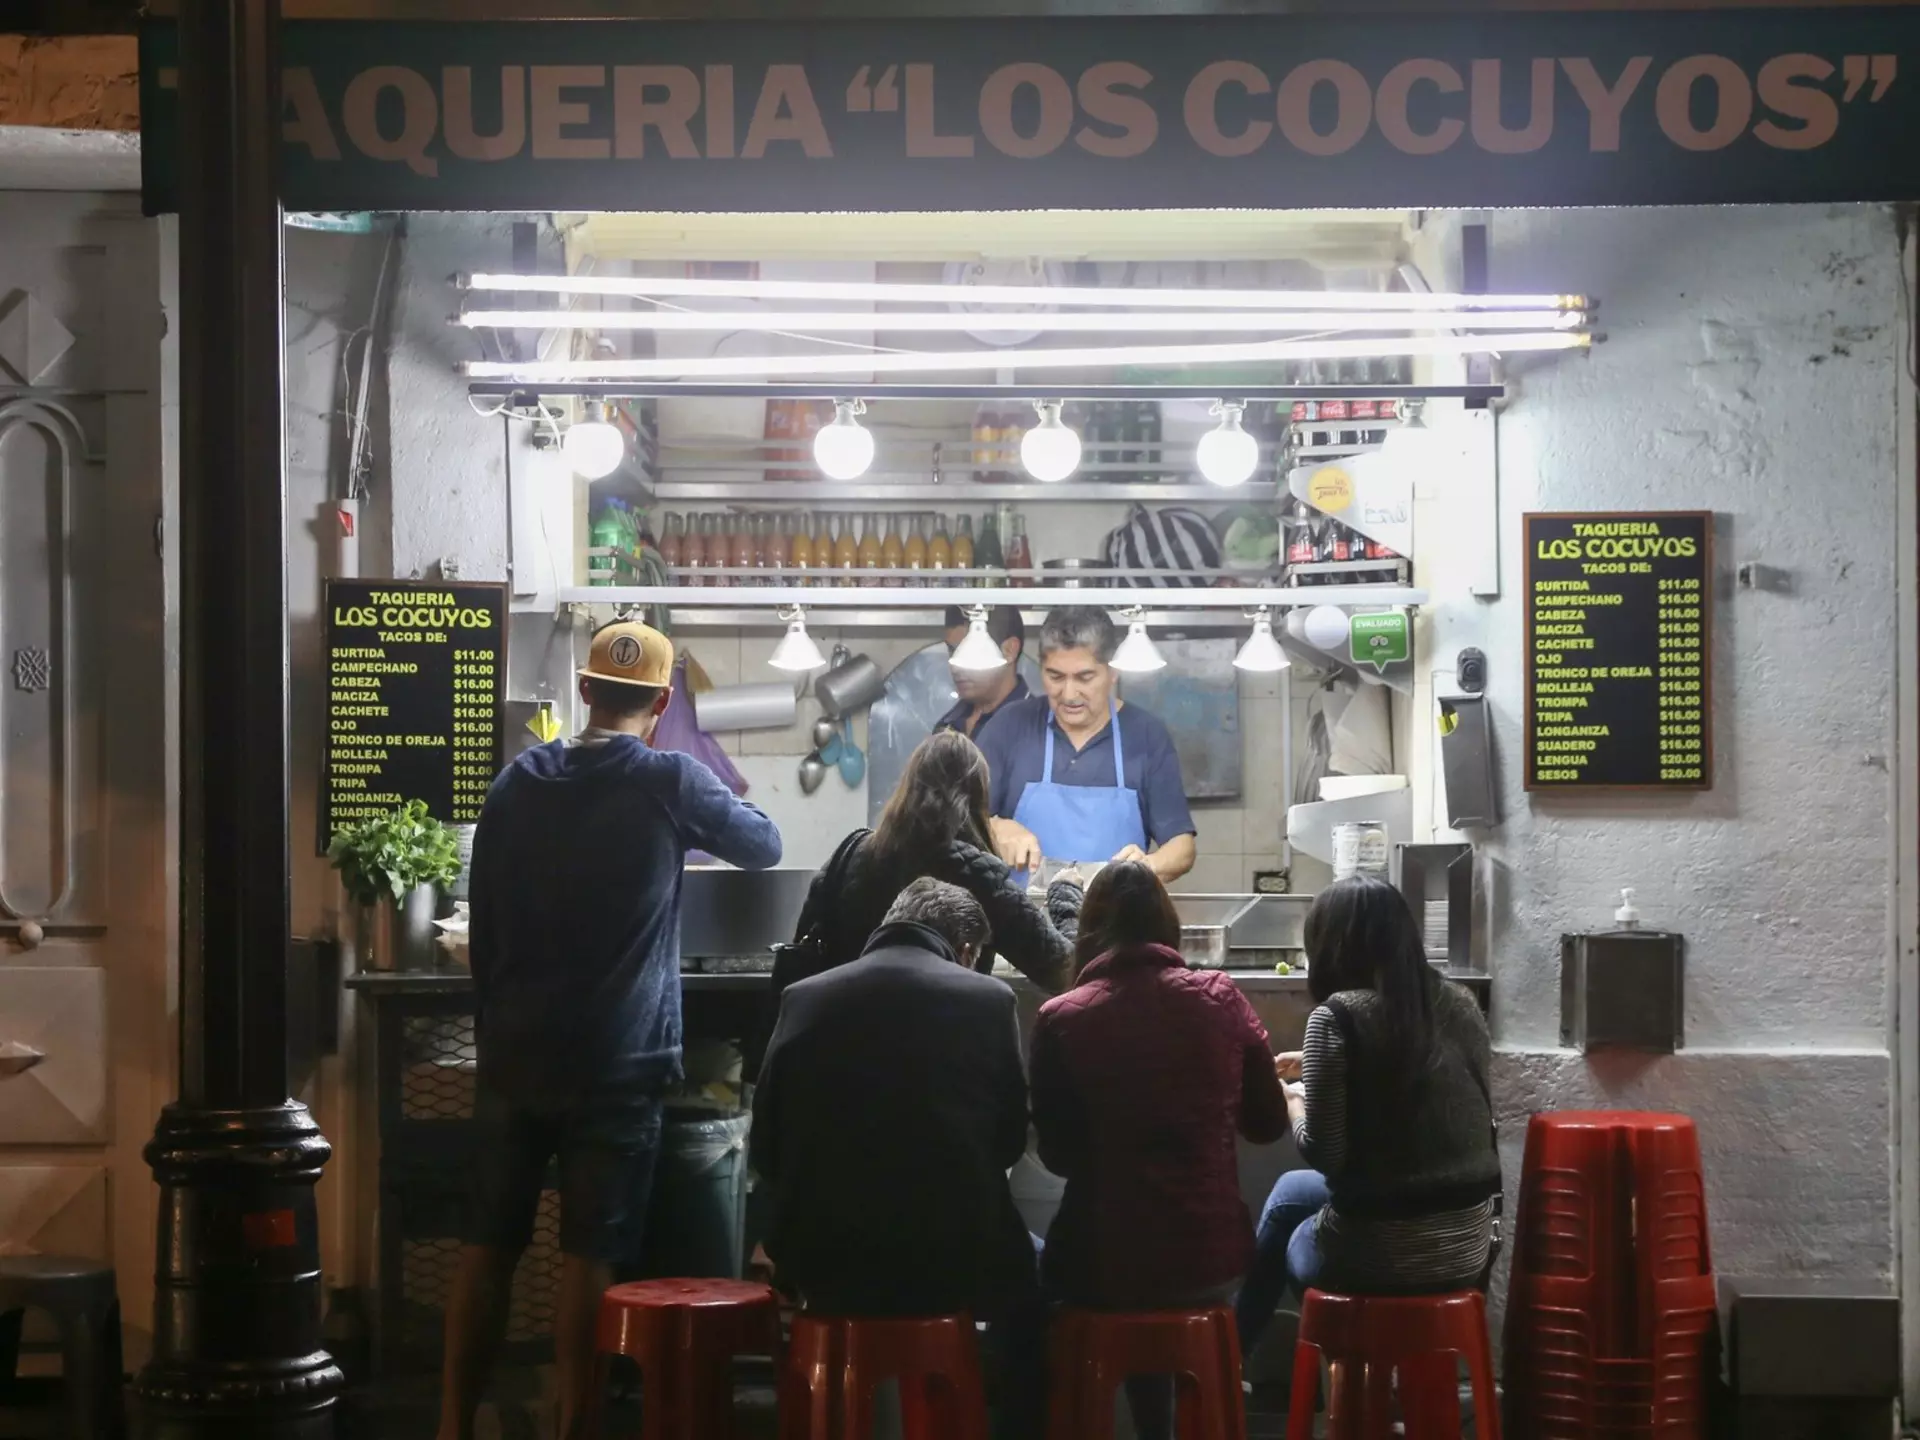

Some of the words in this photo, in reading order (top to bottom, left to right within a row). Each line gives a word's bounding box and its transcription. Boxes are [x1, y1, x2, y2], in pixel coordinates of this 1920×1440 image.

[157, 63, 835, 178] AQUERIA
[1573, 523, 1659, 536] TAQUERIA
[1538, 540, 1581, 558] LOS
[1586, 538, 1696, 558] COCUYOS
[1582, 563, 1626, 573] TACOS
[1536, 581, 1589, 592] SURTIDA
[370, 592, 455, 606] TAQUERIA
[1536, 595, 1622, 606] CAMPECHANO
[335, 607, 377, 626] LOS
[383, 607, 492, 628] COCUYOS
[1536, 610, 1585, 621] CABEZA
[1536, 625, 1584, 635] MACIZA
[378, 631, 422, 641] TACOS
[426, 632, 447, 642] DE:
[1536, 639, 1594, 650] CACHETE
[332, 648, 385, 659] SURTIDA
[453, 650, 494, 661] $11.00
[1536, 654, 1562, 665] OJO
[332, 663, 417, 674] CAMPECHANO
[453, 664, 494, 675] $16.00
[1536, 668, 1588, 678] TRONCO
[1592, 668, 1608, 678] DE
[1611, 668, 1651, 678] OREJA
[332, 678, 380, 688] CABEZA
[453, 679, 494, 690] $16.00
[1537, 682, 1593, 693] MOLLEJA
[332, 692, 378, 702] MACIZA
[453, 694, 494, 704] $16.00
[1537, 697, 1588, 708] TROMPA
[332, 706, 389, 717] CACHETE
[453, 708, 494, 719] $16.00
[1537, 712, 1573, 722] TRIPA
[332, 721, 356, 732] OJO
[453, 722, 494, 733] $16.00
[1537, 726, 1609, 736] LONGANIZA
[332, 735, 382, 746] TRONCO
[386, 735, 401, 746] DE
[407, 735, 445, 746] OREJA
[453, 737, 494, 747] $16.00
[1537, 740, 1595, 751] SUADERO
[331, 750, 387, 761] MOLLEJA
[453, 751, 494, 762] $16.00
[1538, 755, 1588, 766] LENGUA
[331, 764, 381, 775] TROMPA
[453, 766, 494, 776] $16.00
[1538, 770, 1578, 780] SESOS
[331, 779, 366, 789] TRIPA
[331, 793, 401, 804] LONGANIZA
[453, 795, 485, 805] $16.0
[331, 808, 388, 818] SUADERO
